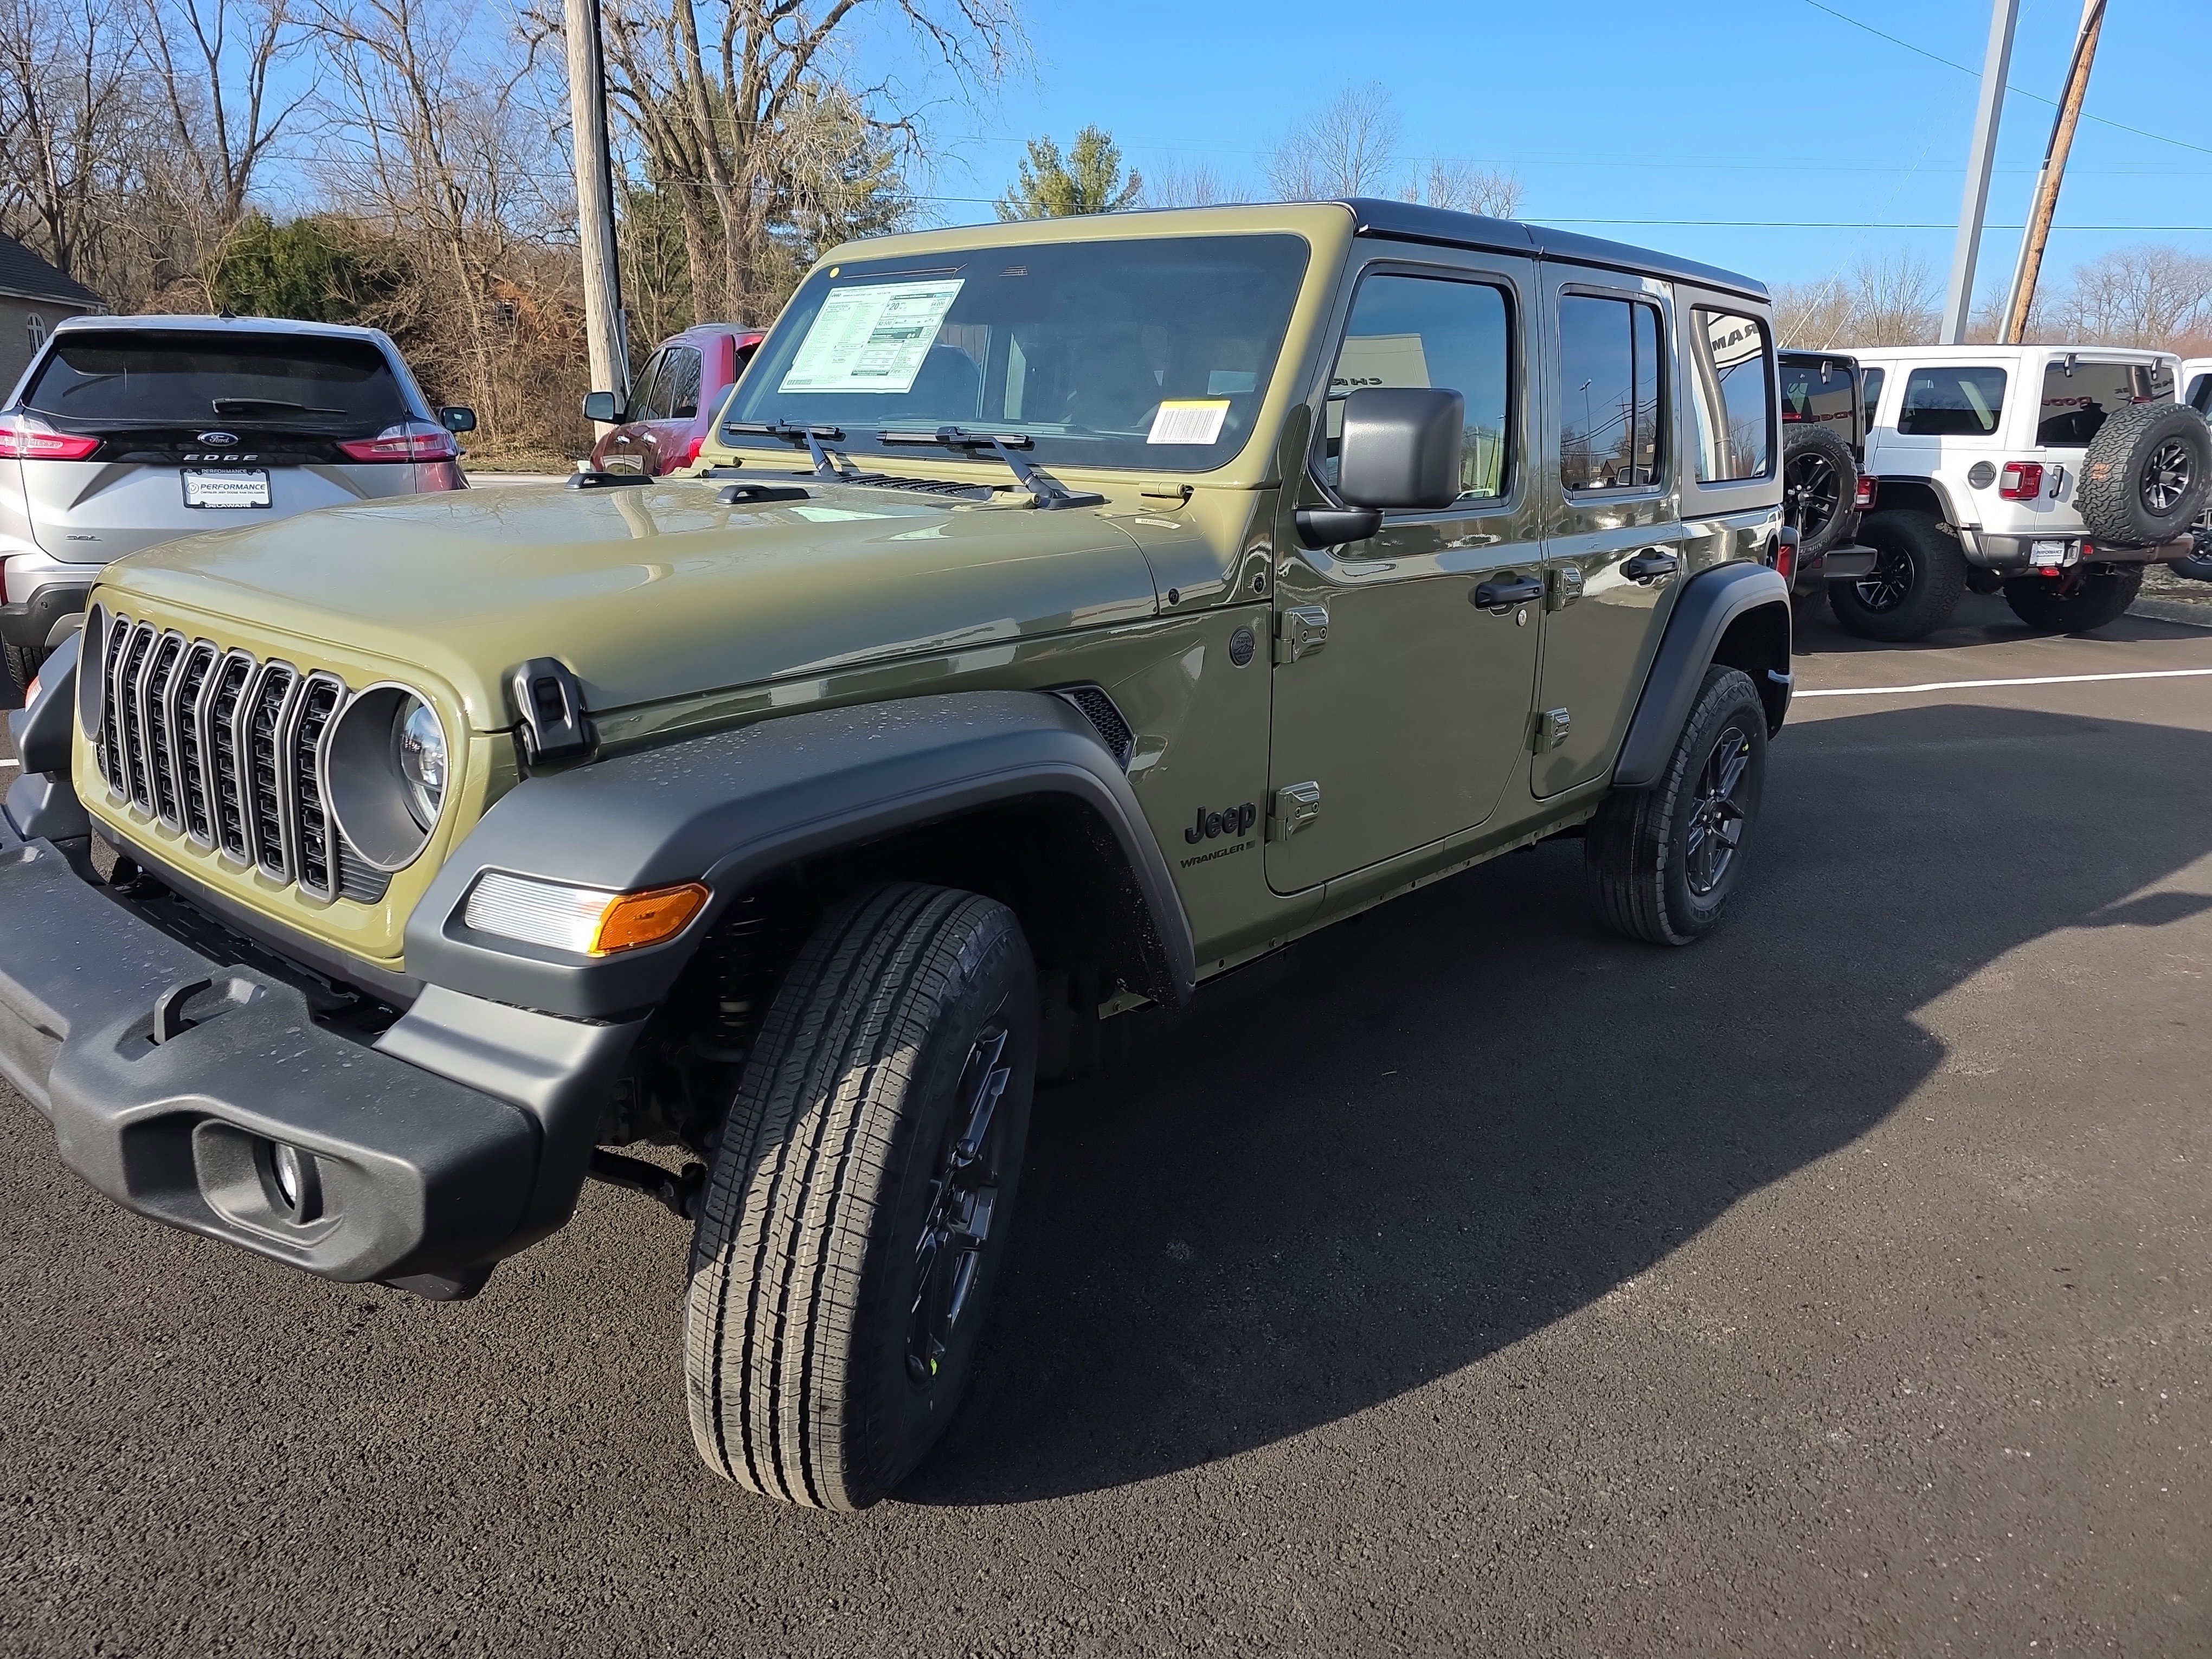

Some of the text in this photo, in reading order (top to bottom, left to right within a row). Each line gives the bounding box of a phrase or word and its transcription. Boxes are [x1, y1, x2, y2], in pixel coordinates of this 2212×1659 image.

[209, 435, 229, 443] Ford
[1185, 802, 1256, 844] Jeep
[1180, 843, 1244, 868] WRANGLER
